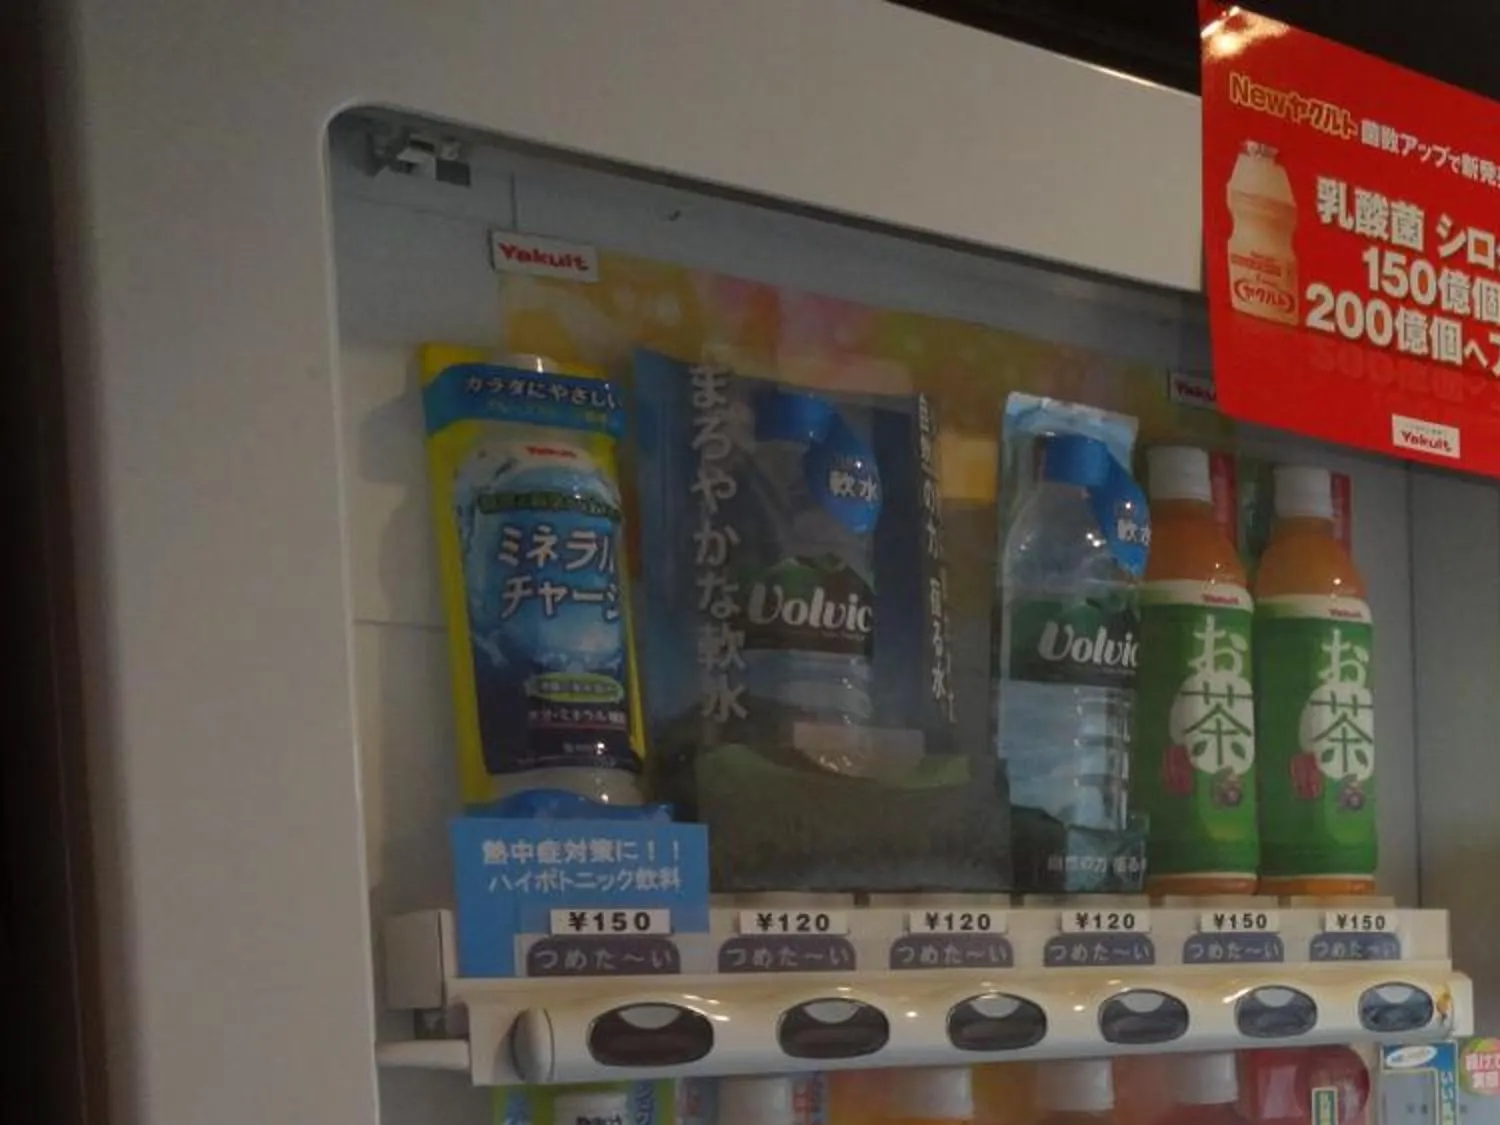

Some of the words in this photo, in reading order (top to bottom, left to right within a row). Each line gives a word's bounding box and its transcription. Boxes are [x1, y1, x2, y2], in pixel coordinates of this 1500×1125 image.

[1315, 175, 1426, 252] 乳酸菌
[499, 242, 589, 272] Yakult
[688, 364, 749, 722] まろやかな軟水
[747, 582, 875, 634] Volvic
[1181, 614, 1253, 766] お茶
[1310, 628, 1374, 773] お茶
[568, 912, 652, 932] ¥150
[756, 913, 831, 932] ¥120
[924, 912, 991, 931] ¥120
[1076, 912, 1135, 931] ¥120
[1213, 911, 1268, 931] ¥150
[1337, 912, 1386, 931] ¥150
